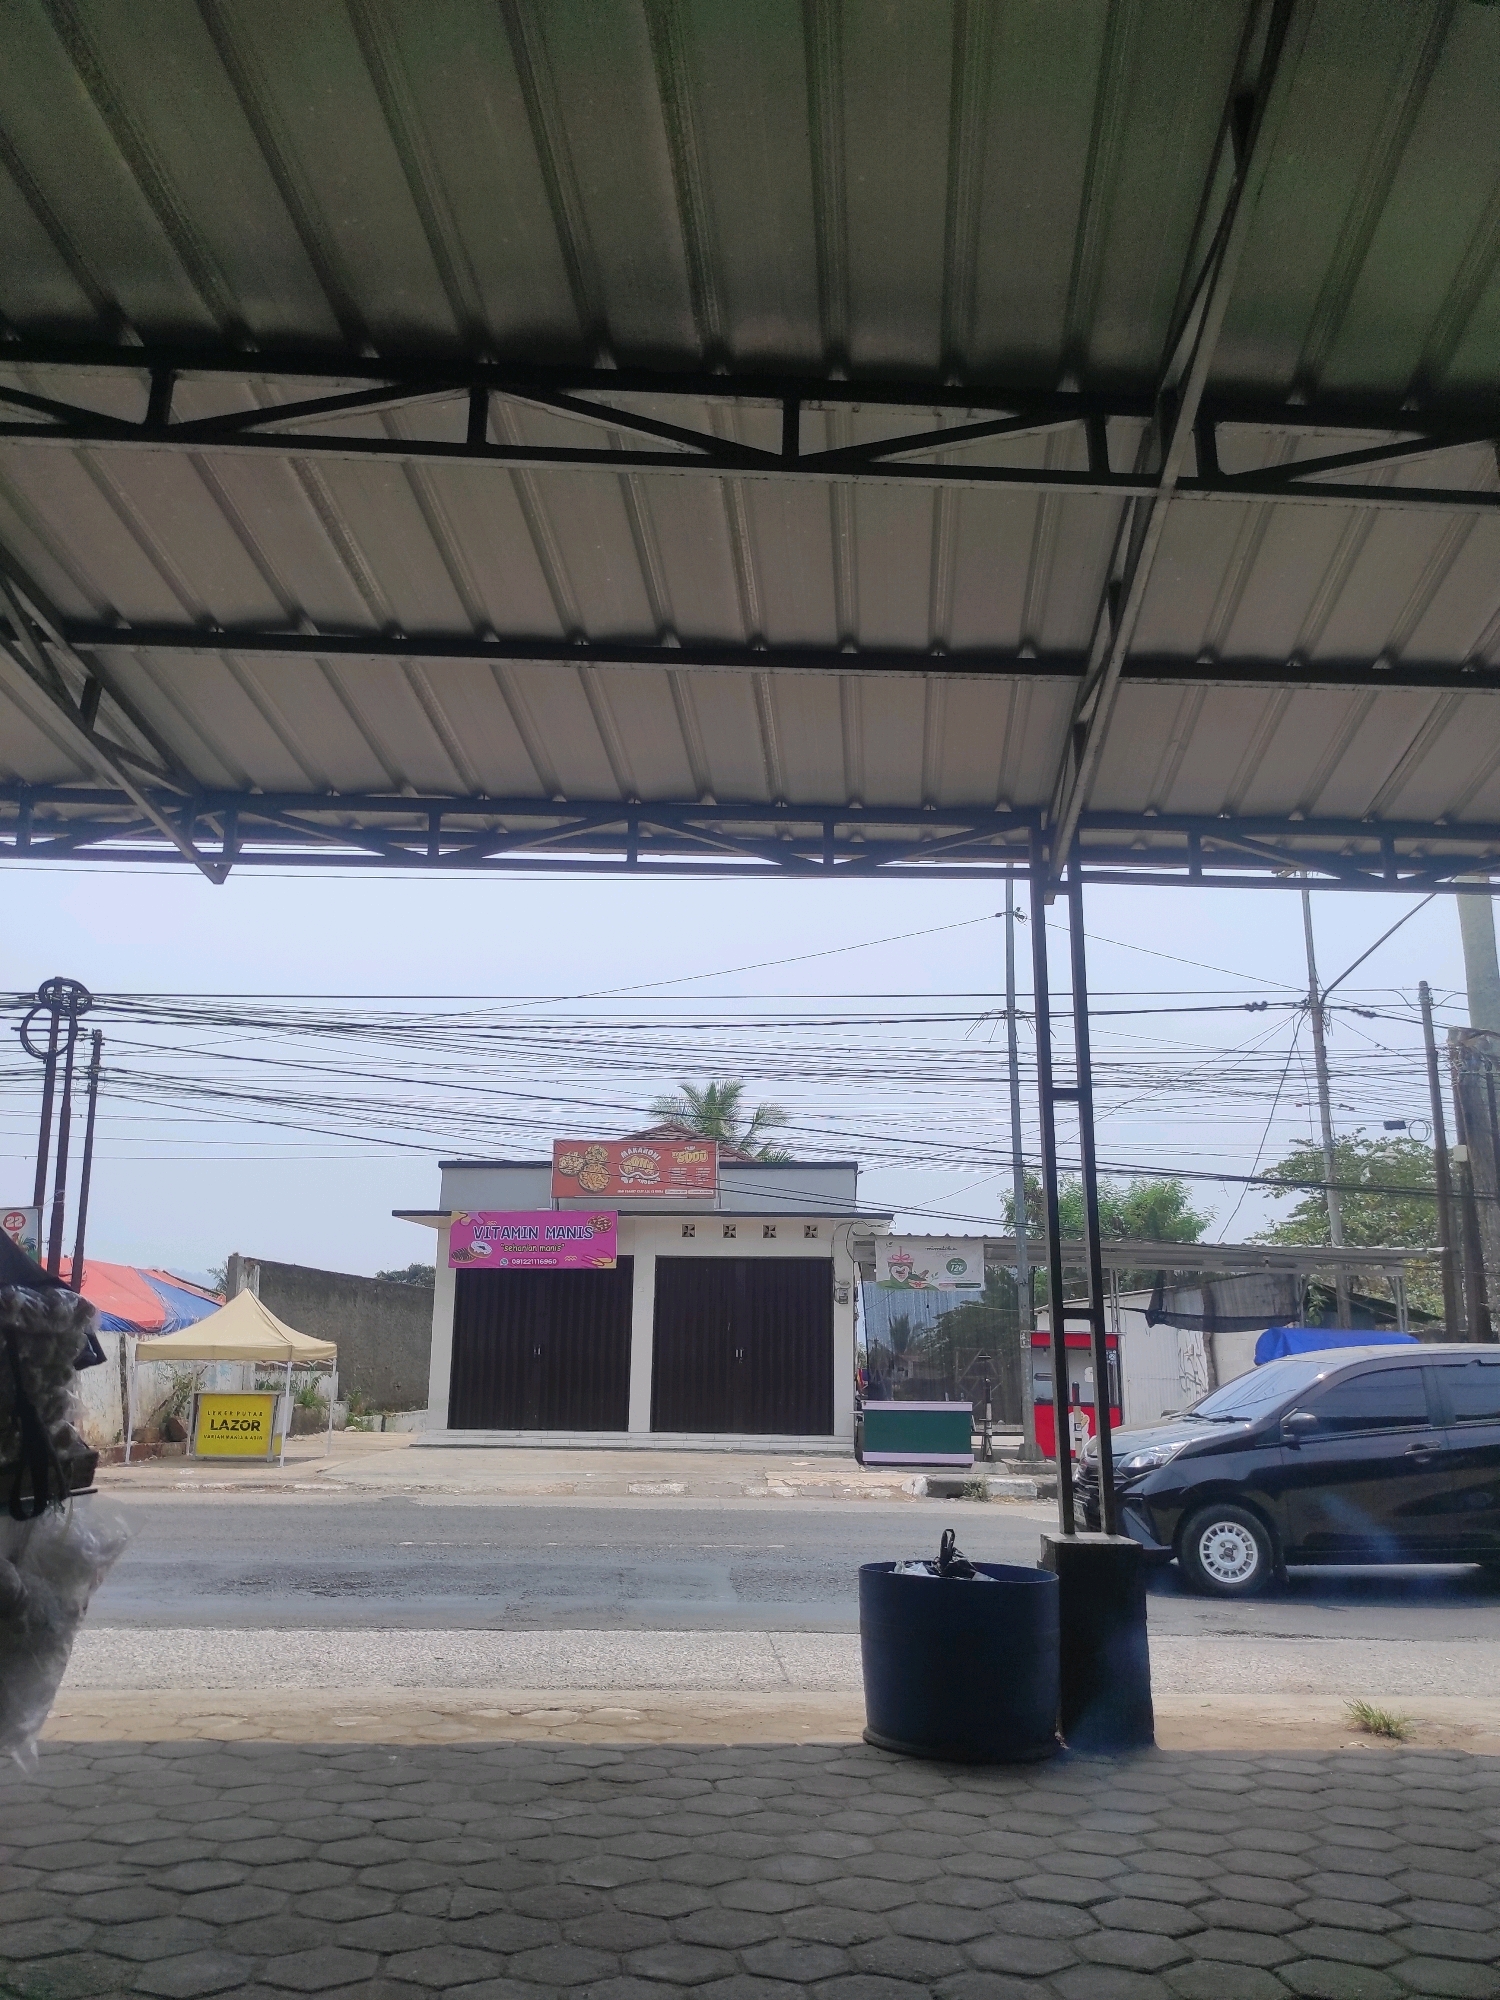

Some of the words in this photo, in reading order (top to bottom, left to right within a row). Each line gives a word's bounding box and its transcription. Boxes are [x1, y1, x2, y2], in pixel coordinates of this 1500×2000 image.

[620, 1147, 661, 1161] MAKARONI
[6, 1216, 22, 1227] 22
[473, 1226, 539, 1240] VITAMIN
[545, 1226, 594, 1240] MANIS
[210, 1419, 260, 1431] LAZOR
